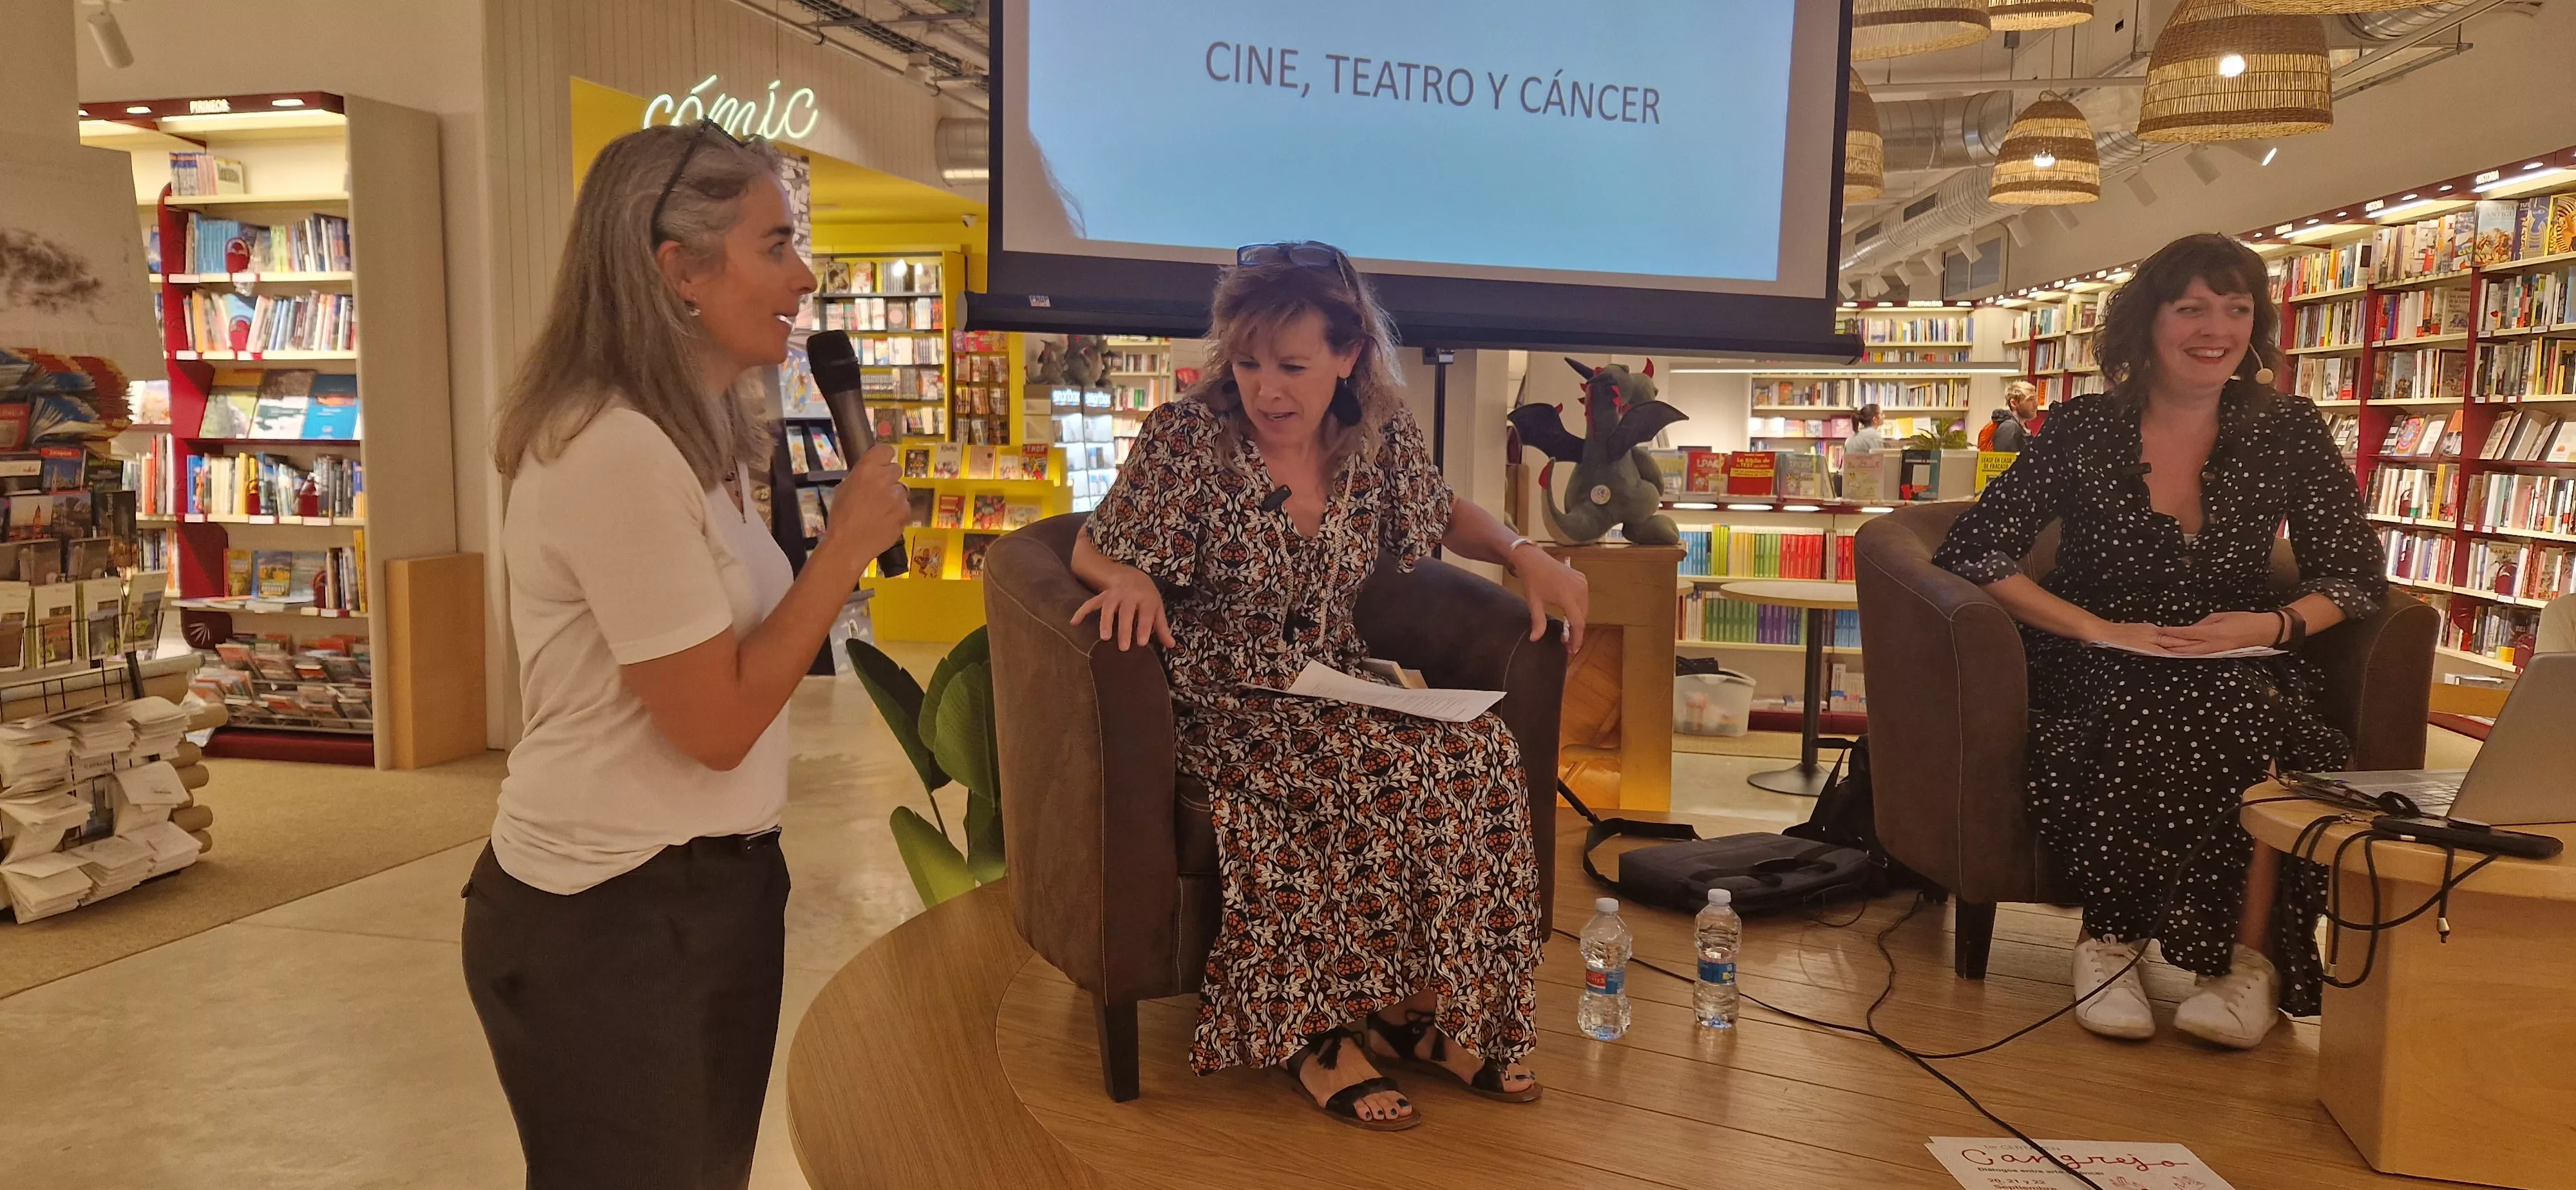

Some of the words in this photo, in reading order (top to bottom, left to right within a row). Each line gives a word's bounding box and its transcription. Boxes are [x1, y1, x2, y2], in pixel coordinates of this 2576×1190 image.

[643, 74, 818, 140] cómic
[1206, 41, 1310, 98] CINE,
[1325, 54, 1474, 107] TEATRO
[1487, 71, 1508, 110] Y
[1520, 69, 1660, 124] CÁNCER
[1961, 1149, 2190, 1171] Cangrejo
